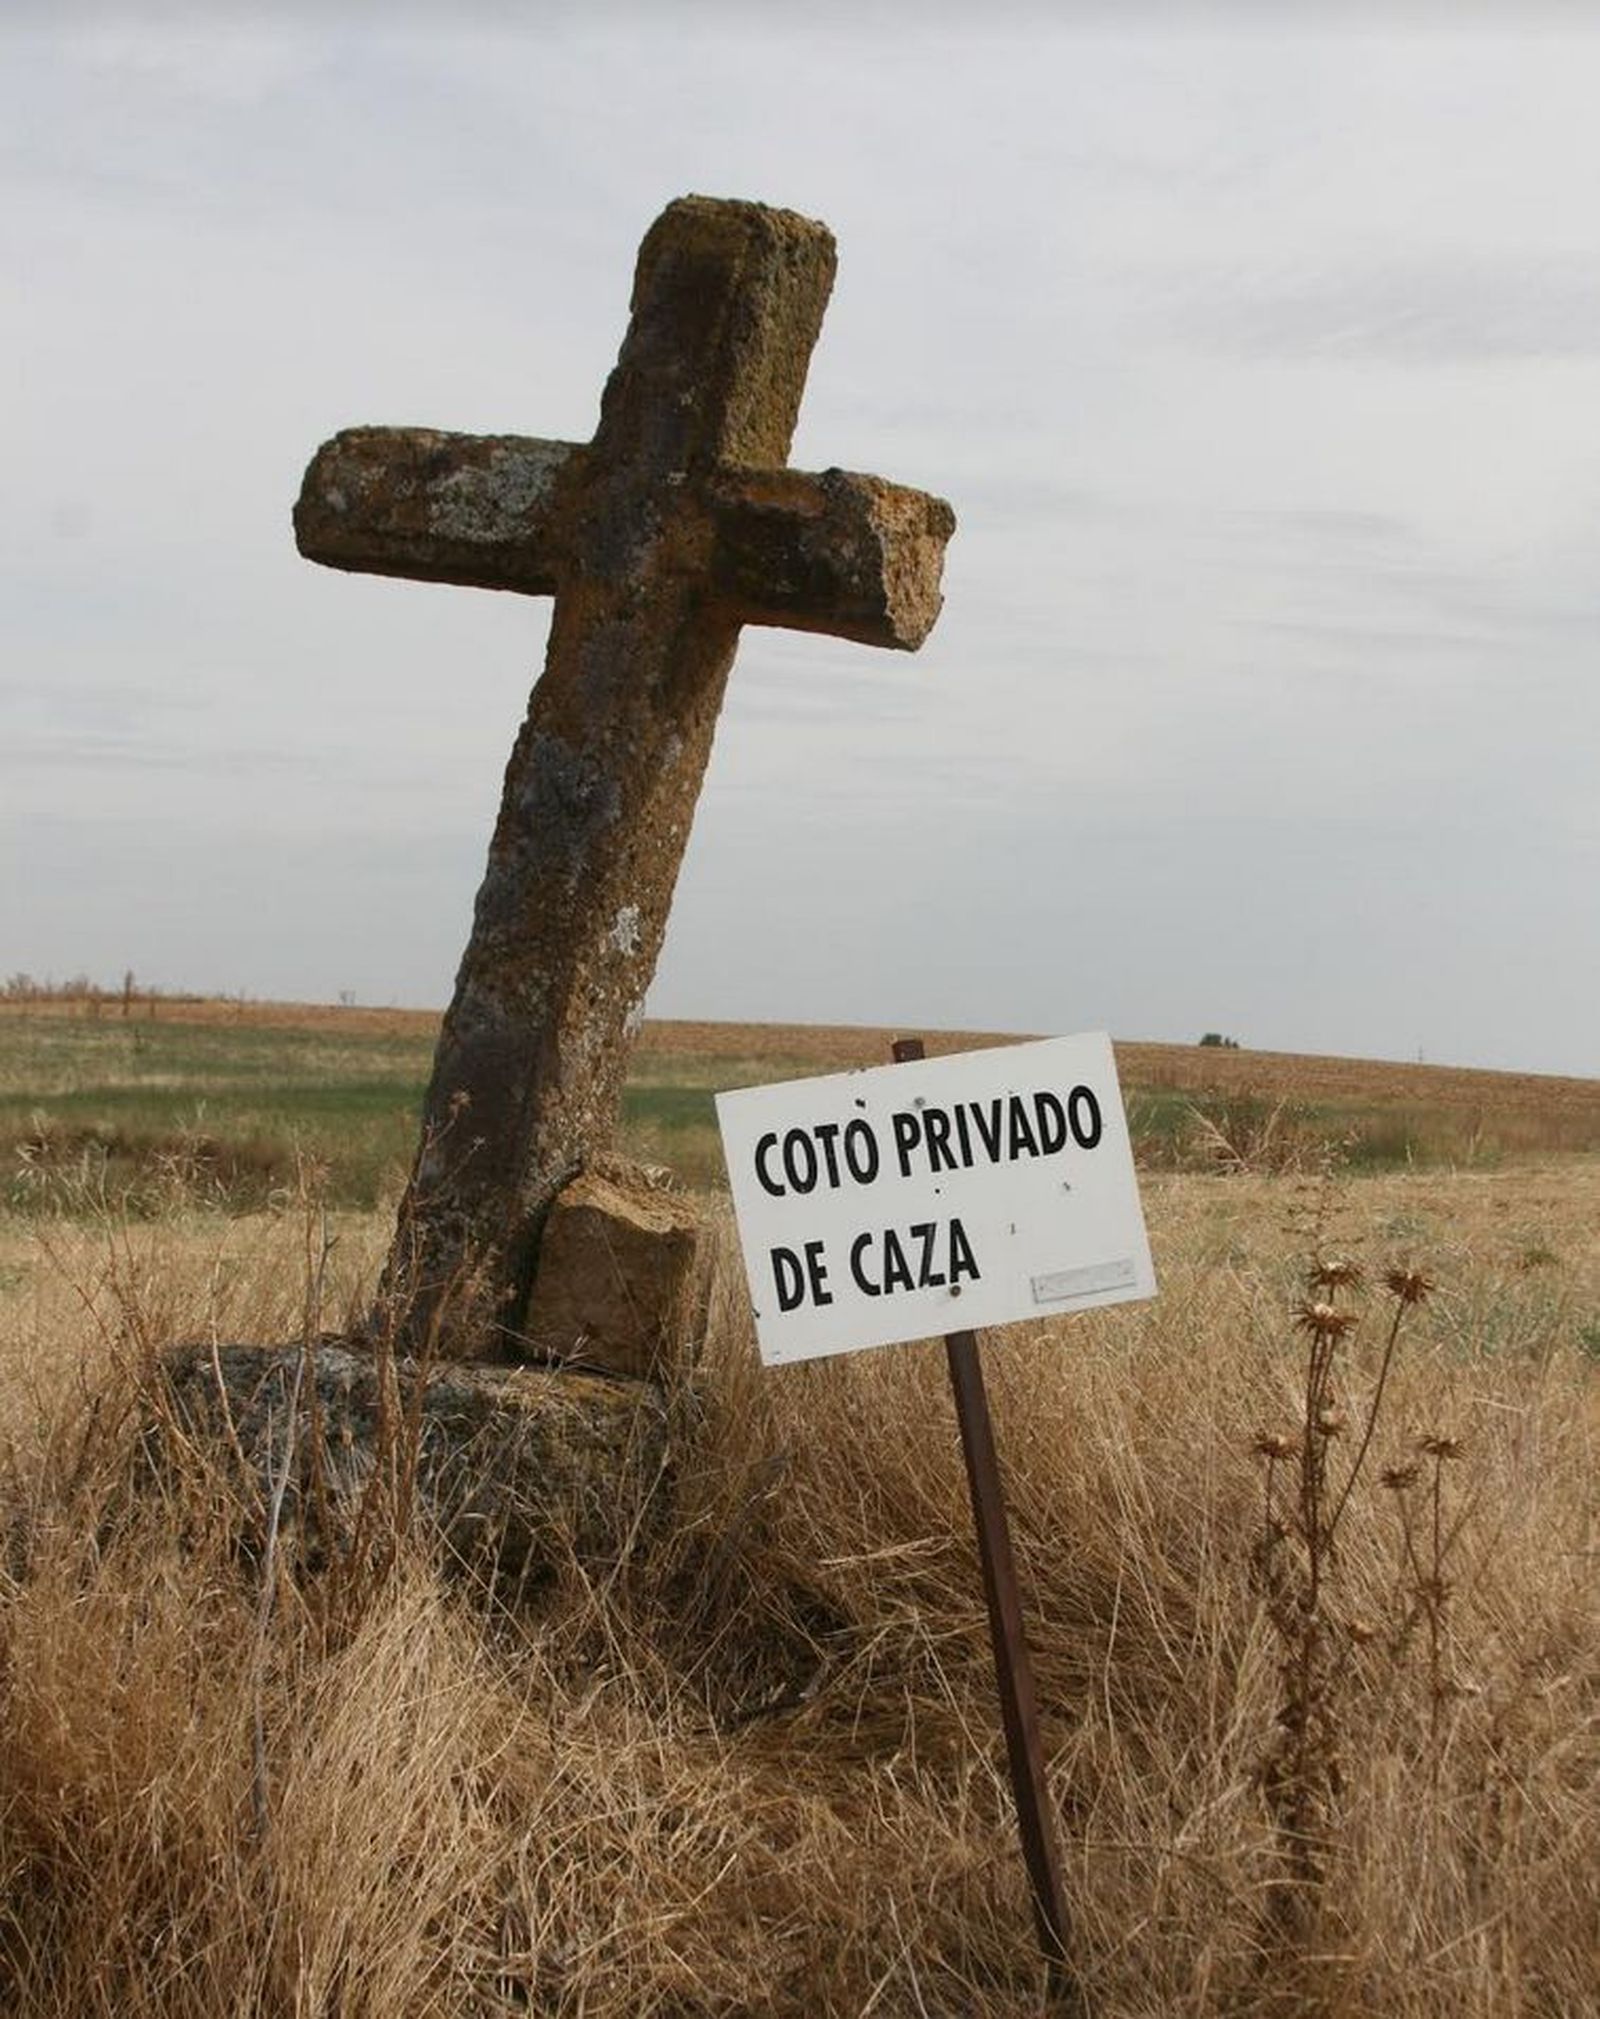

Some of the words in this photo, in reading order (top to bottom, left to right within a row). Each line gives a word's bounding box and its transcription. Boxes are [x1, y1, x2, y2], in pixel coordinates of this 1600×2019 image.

[754, 1118, 880, 1197] COTO
[892, 1085, 1103, 1178] PRIVADO
[770, 1240, 833, 1313] DE
[850, 1218, 981, 1297] CAZA
